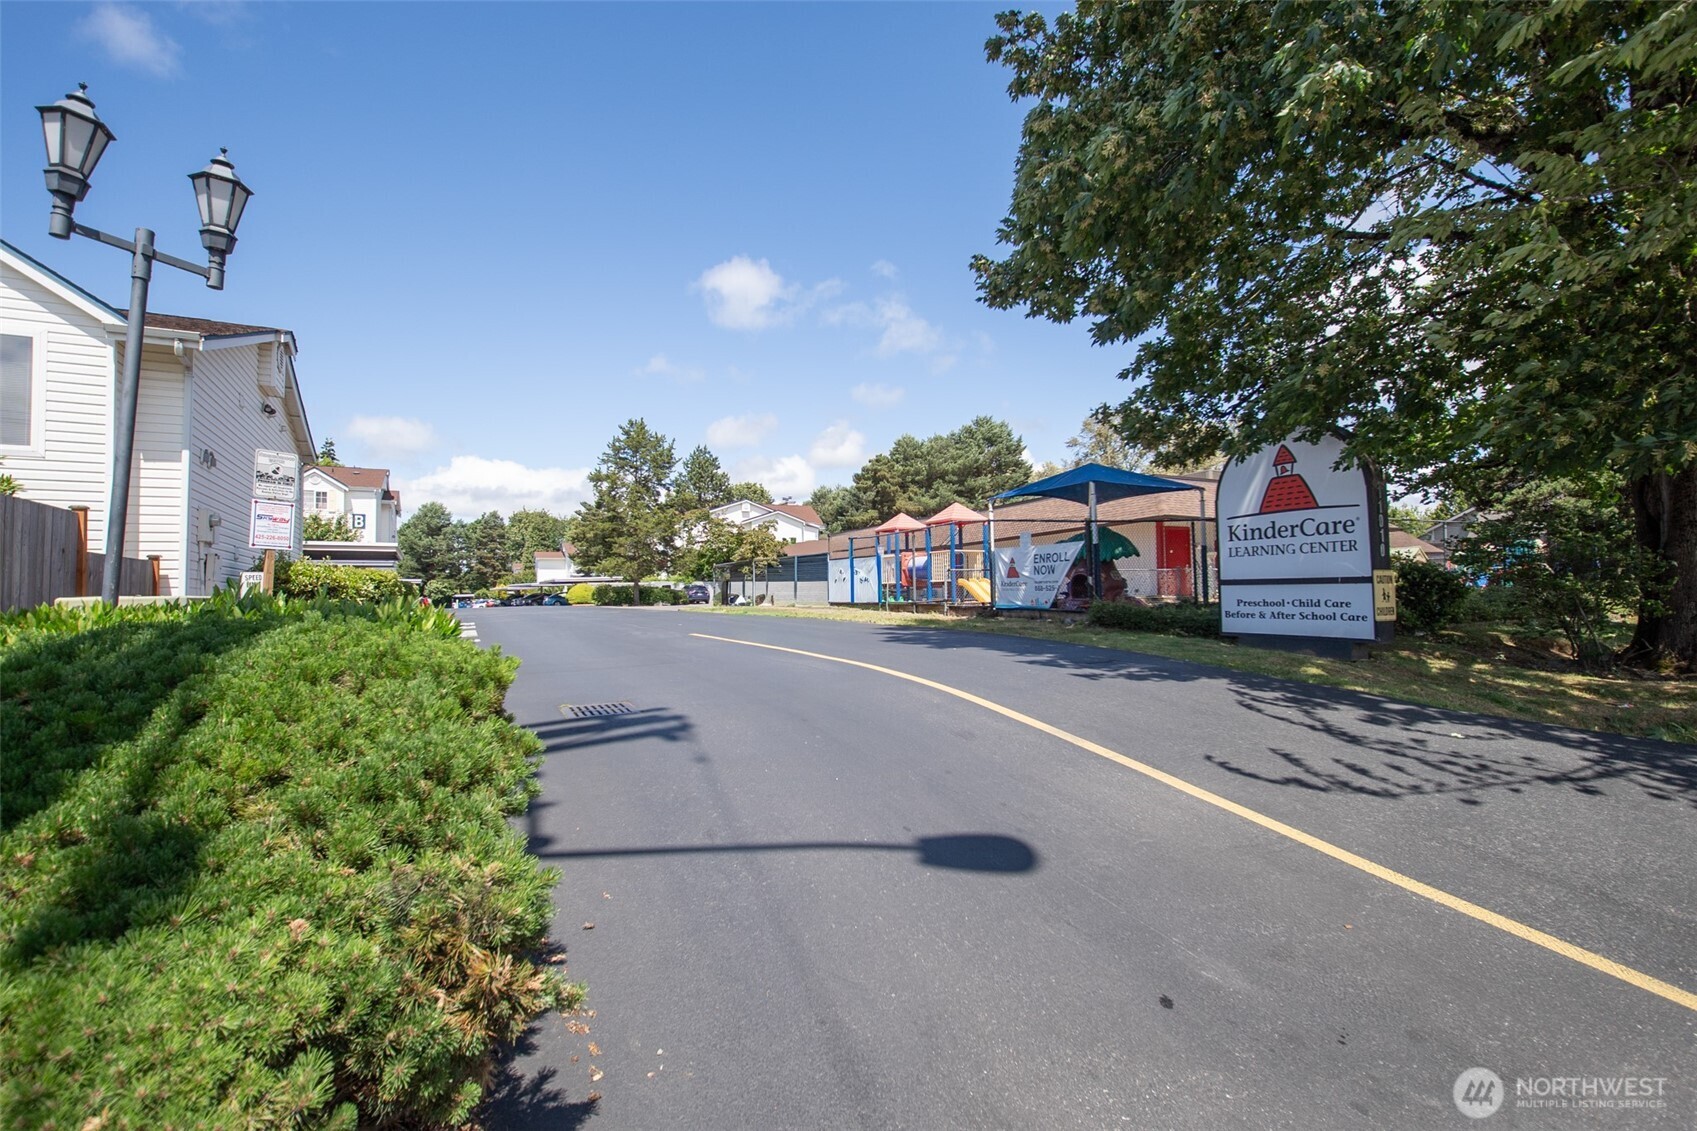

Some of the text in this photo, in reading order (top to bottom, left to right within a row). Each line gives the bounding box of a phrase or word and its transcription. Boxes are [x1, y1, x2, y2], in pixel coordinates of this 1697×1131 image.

[354, 515, 364, 528] B
[1227, 518, 1356, 542] KinderCare
[1228, 540, 1358, 558] LEARNING CENTER
[1033, 552, 1070, 564] ENROLL
[1033, 564, 1055, 575] NOW
[1236, 598, 1352, 608] Preschool Child Care
[1224, 610, 1368, 622] Before & After School Care
